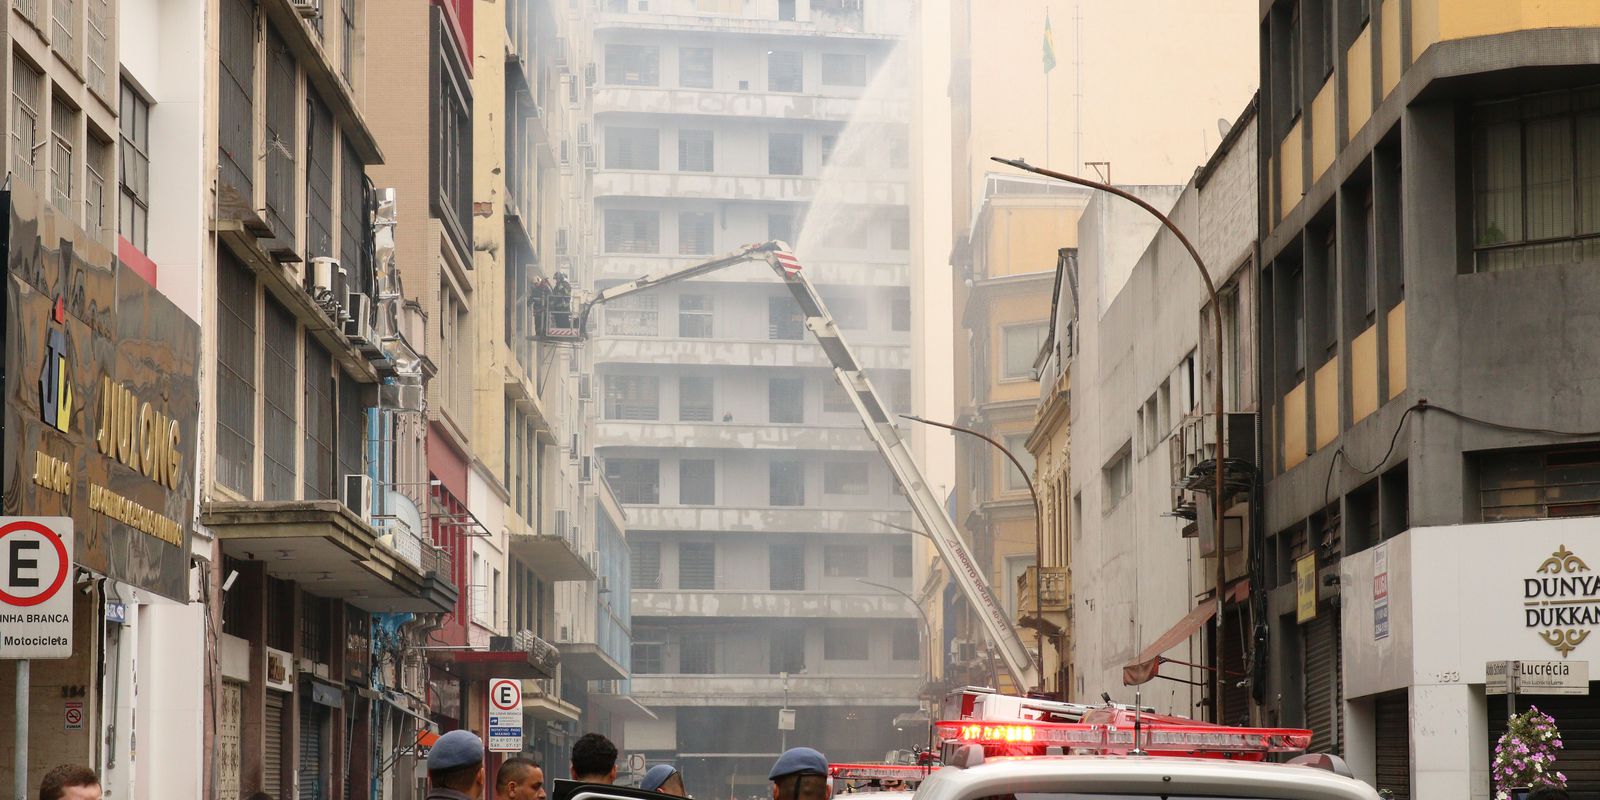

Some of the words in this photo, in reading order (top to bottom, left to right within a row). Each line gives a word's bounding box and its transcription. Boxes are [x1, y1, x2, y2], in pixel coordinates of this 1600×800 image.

[97, 375, 182, 492] JIULONG
[33, 450, 72, 495] JIULONG
[9, 540, 40, 587] E
[955, 547, 977, 578] BRONTO
[974, 579, 994, 607] SKYLIFT
[1523, 575, 1600, 598] DUNYA
[26, 614, 69, 623] BRANCA
[4, 635, 68, 646] Motocicleta
[1437, 671, 1460, 683] 153
[1521, 662, 1569, 675] Lucrécia
[501, 687, 511, 703] E
